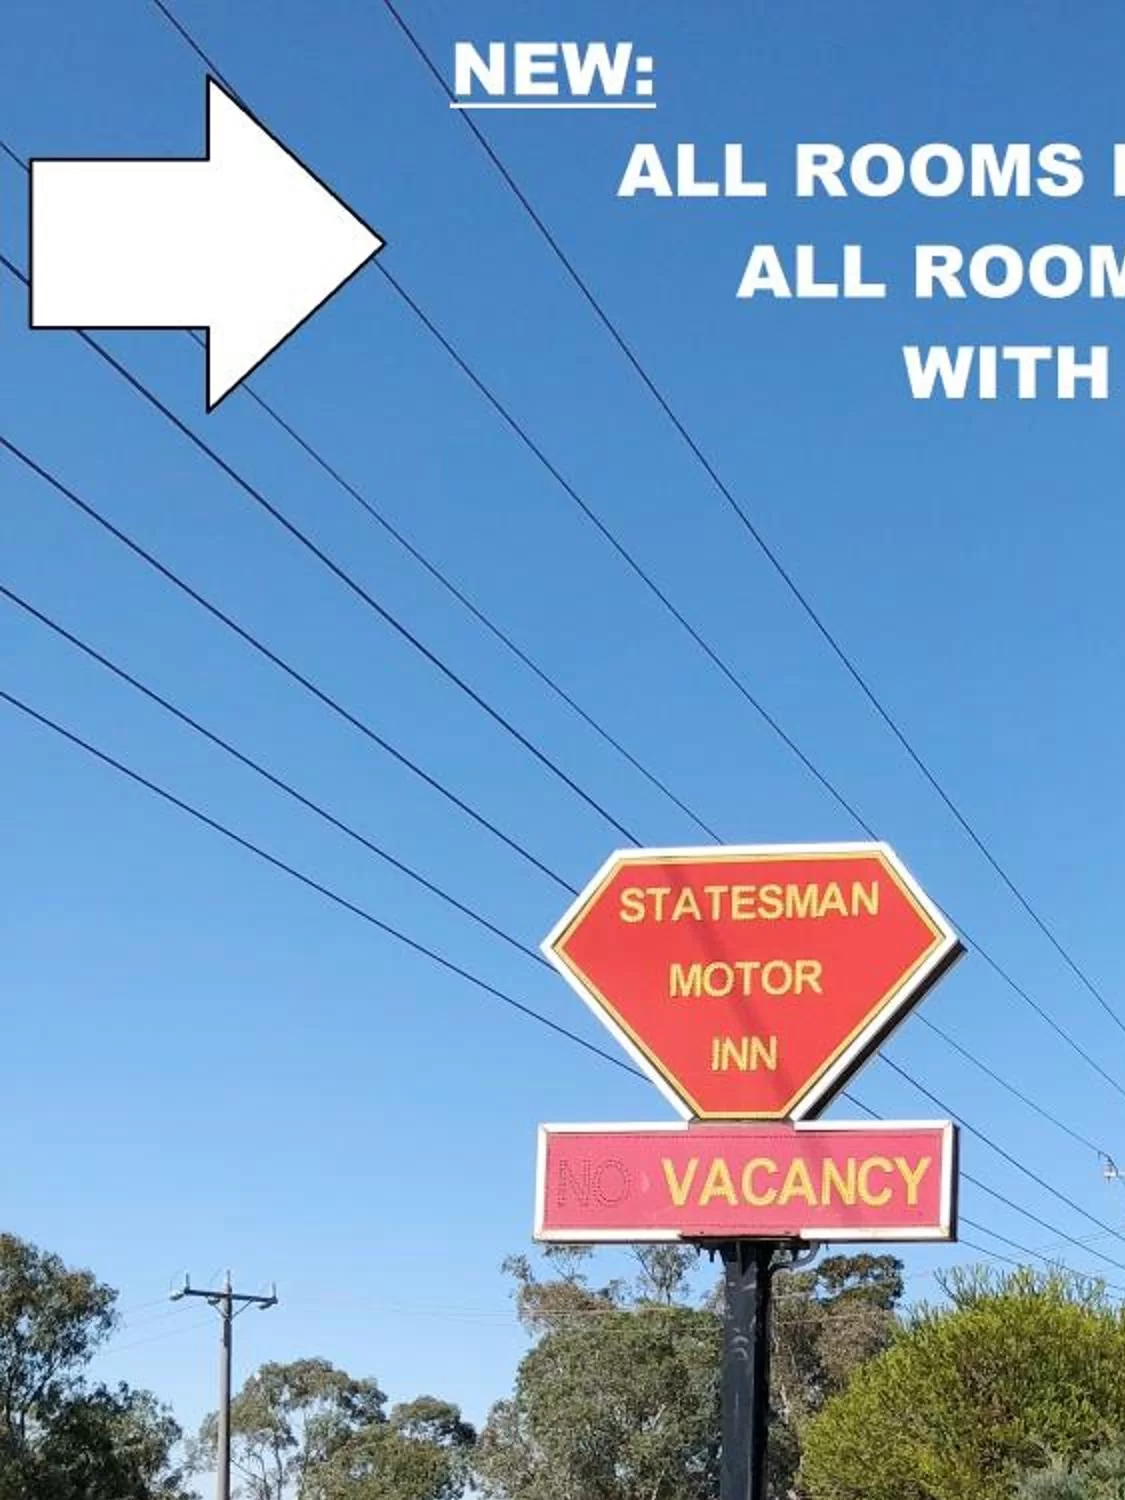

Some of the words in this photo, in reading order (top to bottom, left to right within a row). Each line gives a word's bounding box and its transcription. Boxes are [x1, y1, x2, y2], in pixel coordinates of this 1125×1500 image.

[618, 881, 881, 925] STATESMAN
[668, 959, 824, 999] MOTOR
[711, 1036, 778, 1072] INN
[557, 1158, 633, 1208] NO
[662, 1156, 932, 1209] VACANCY
